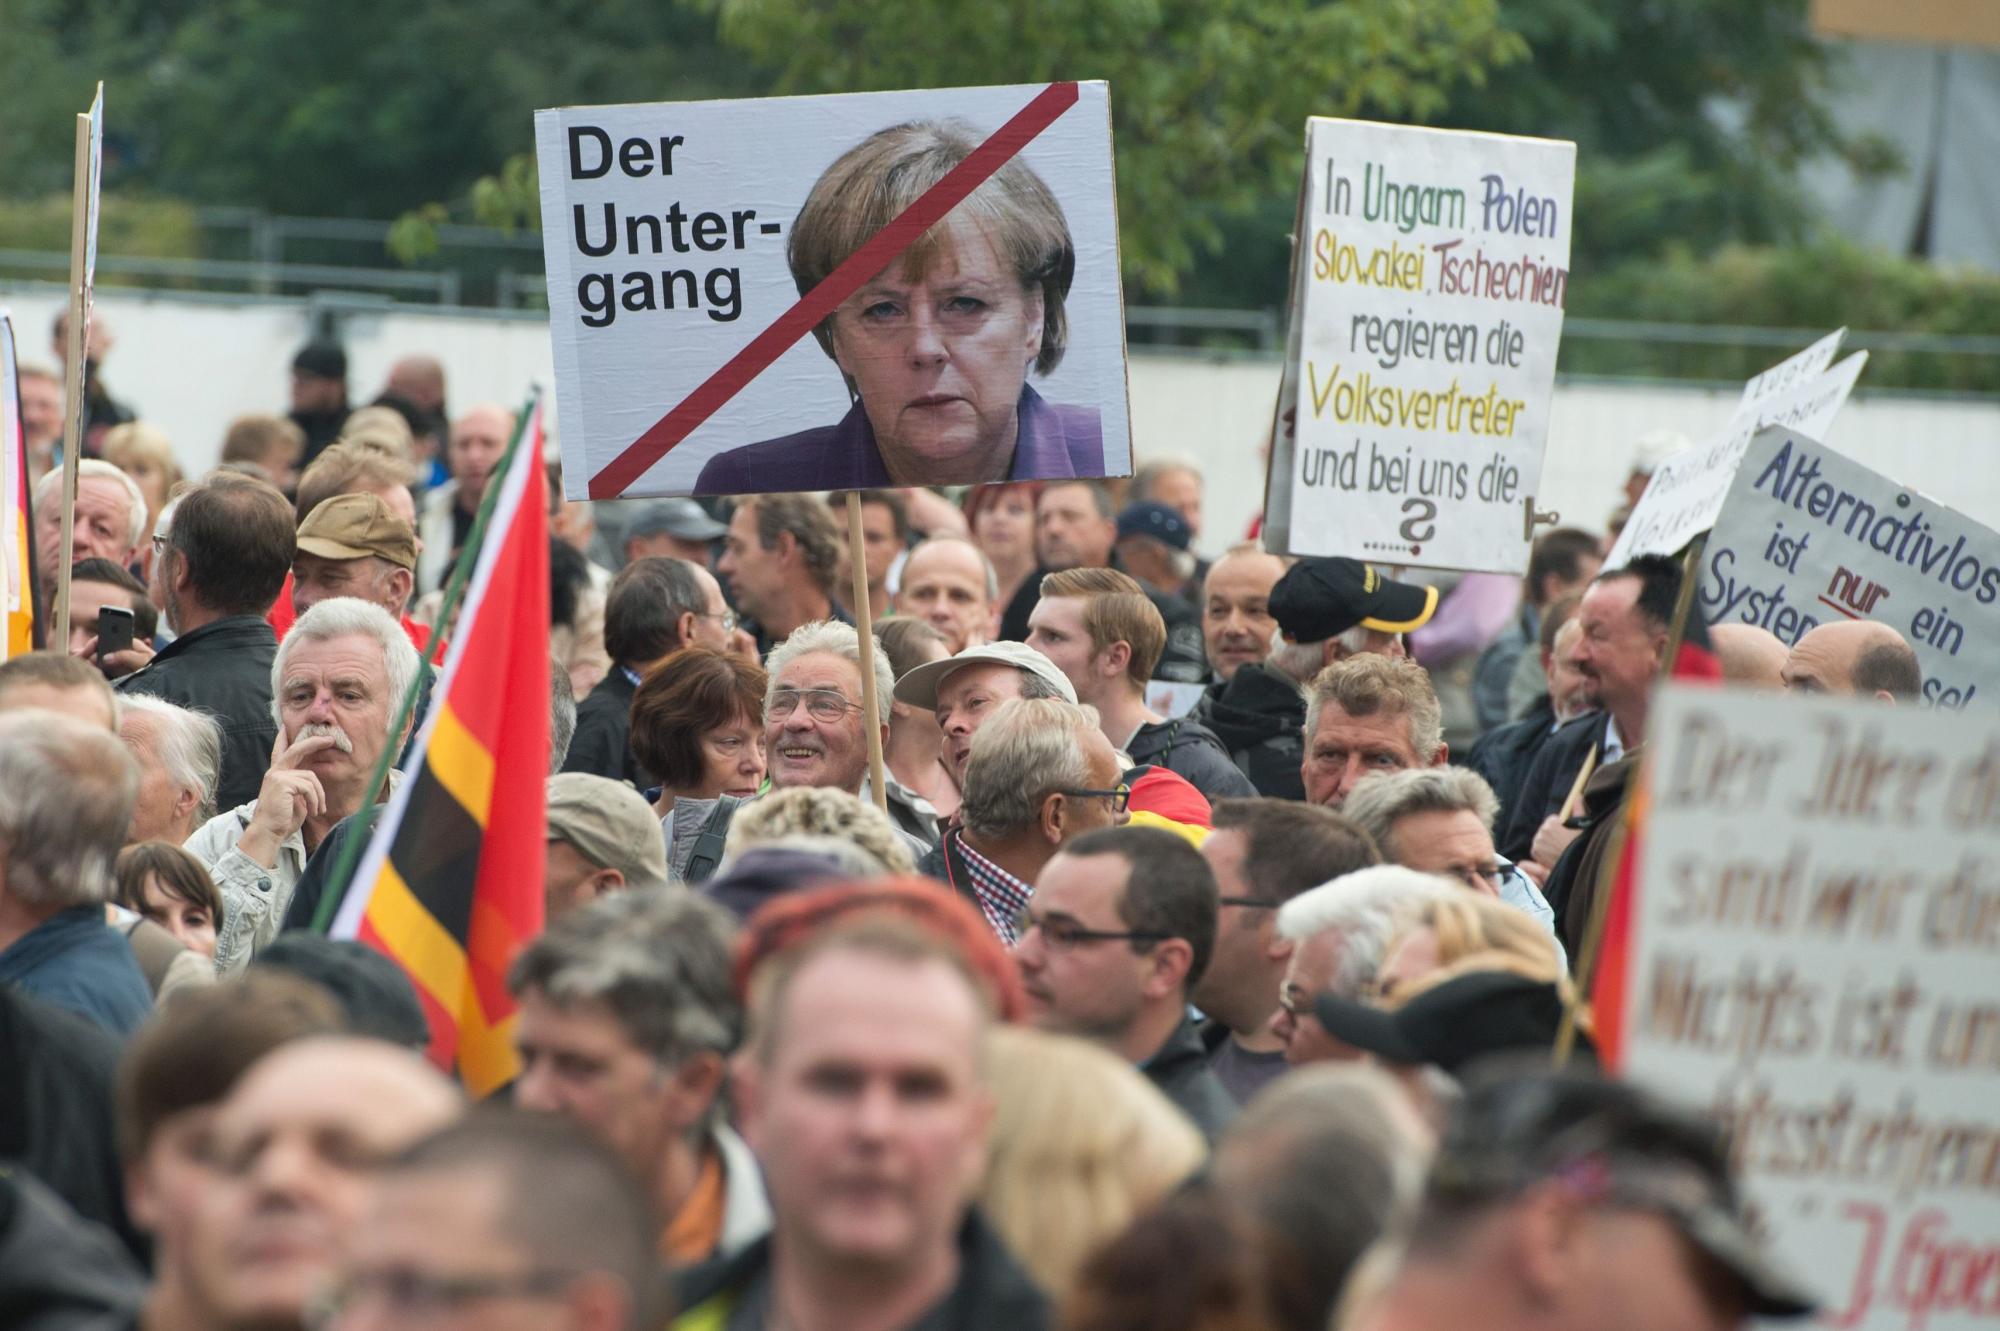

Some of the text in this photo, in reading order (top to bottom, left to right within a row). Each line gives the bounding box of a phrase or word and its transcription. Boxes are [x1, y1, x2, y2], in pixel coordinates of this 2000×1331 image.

[567, 126, 685, 180] Der
[573, 201, 781, 258] Unter-
[1325, 157, 1351, 216] In
[1480, 174, 1557, 239] Polen
[577, 266, 742, 327] gang
[1432, 238, 1570, 310] Tschechien
[1350, 307, 1525, 369] regieren die
[1308, 360, 1526, 439] Volksvertreter
[1302, 437, 1360, 491] und
[1368, 442, 1412, 494] bei
[1418, 457, 1468, 500] uns
[1753, 439, 2000, 605] Alternativlos
[1763, 522, 1964, 656] ist nur ein
